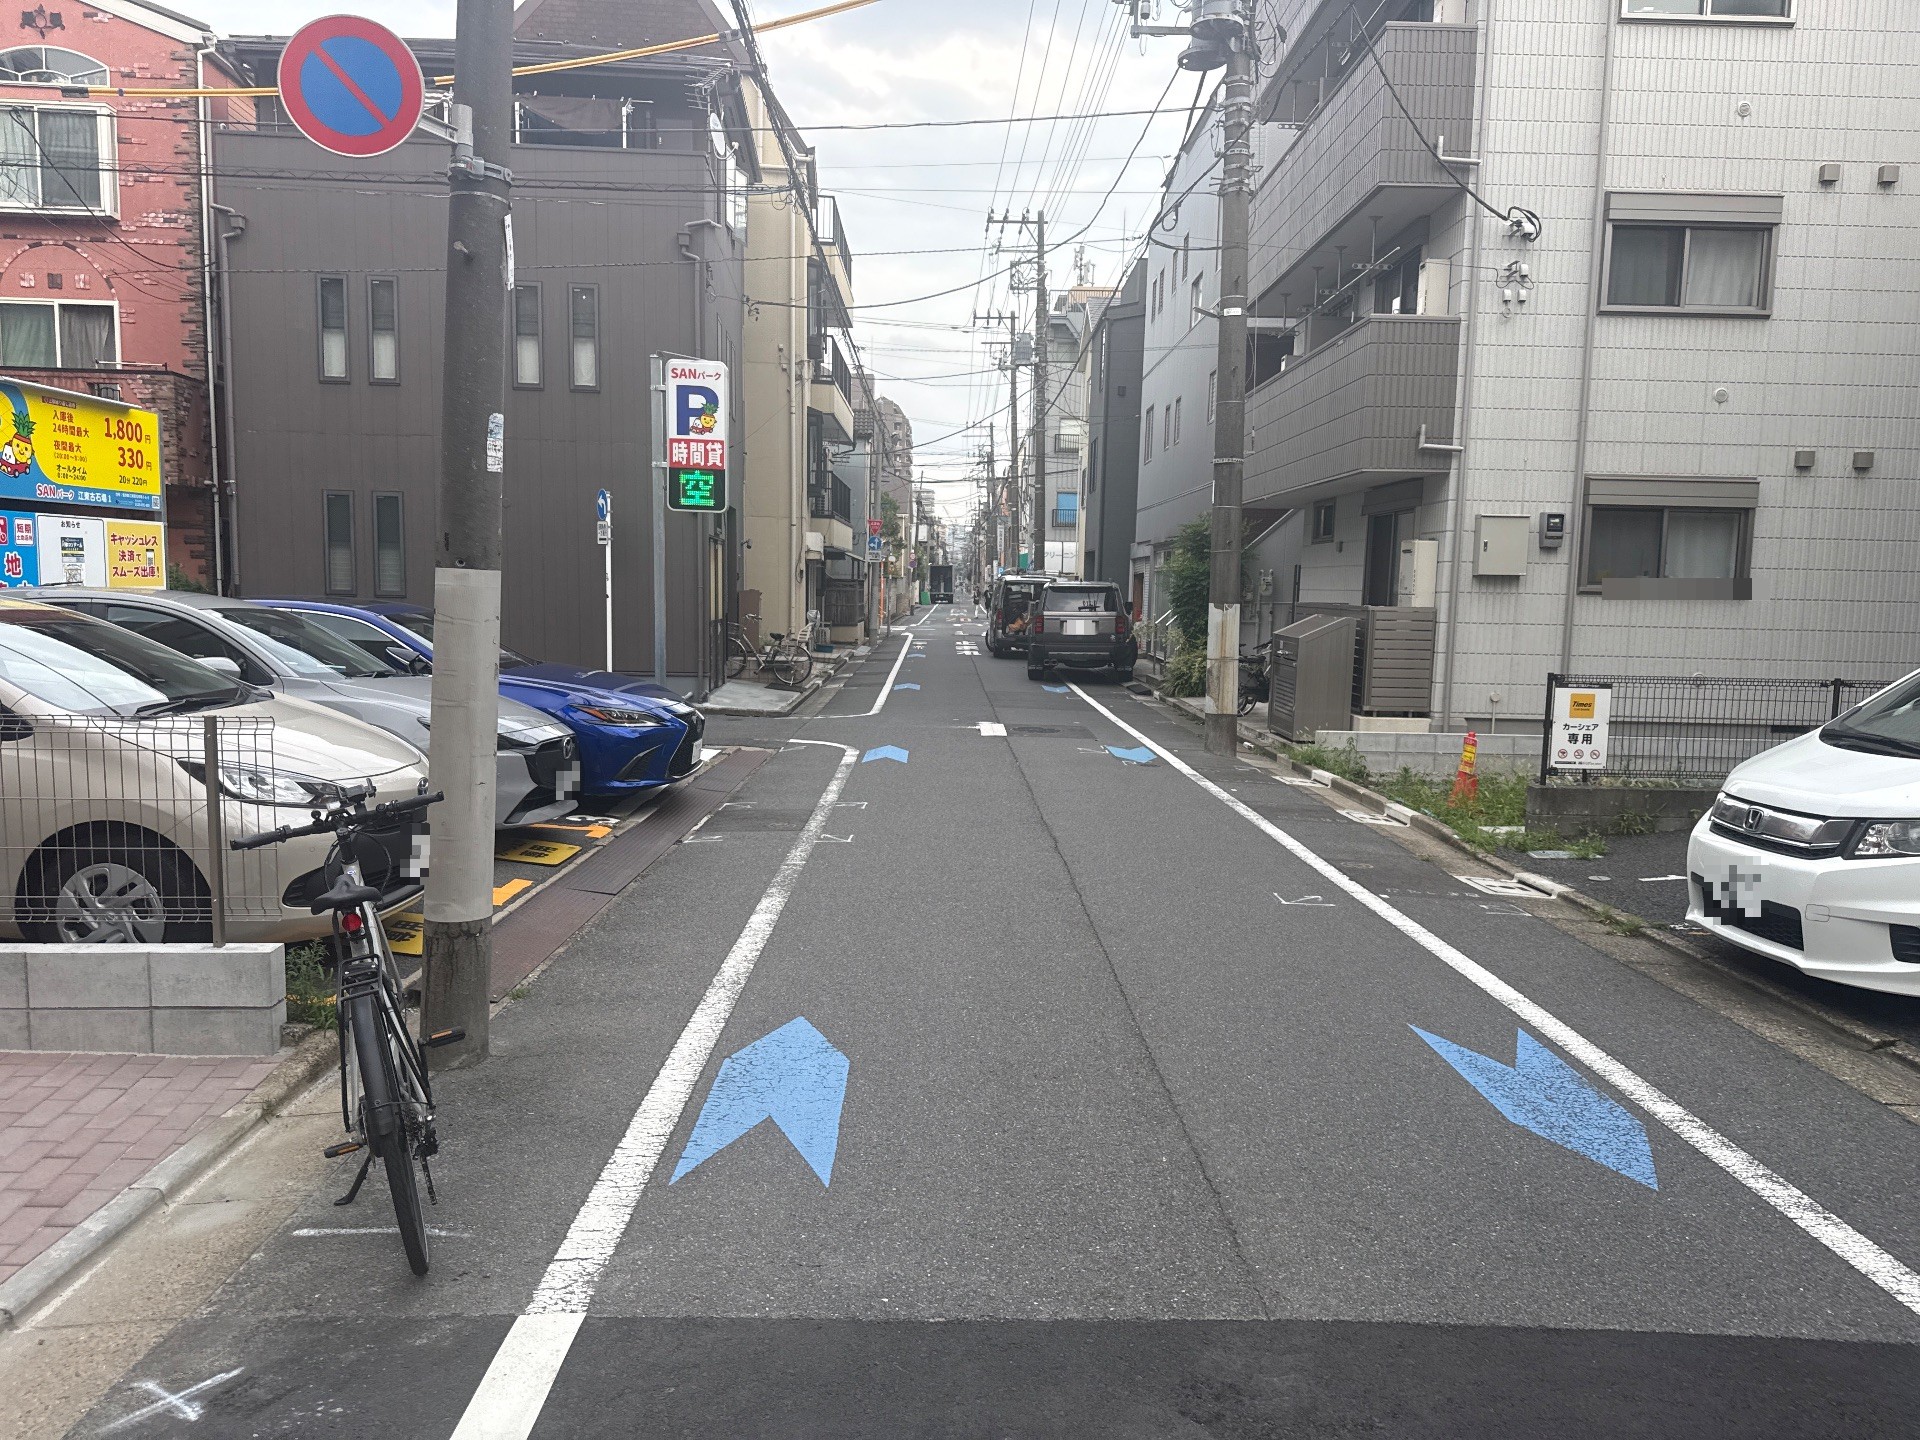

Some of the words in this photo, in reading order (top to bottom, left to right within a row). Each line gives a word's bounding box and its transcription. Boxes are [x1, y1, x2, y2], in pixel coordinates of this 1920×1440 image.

[671, 367, 722, 381] SANパーク
[52, 409, 74, 423] 入庫後
[676, 384, 719, 436] P
[52, 423, 90, 438] 24時間最大
[53, 440, 82, 454] 夜間最大
[672, 441, 723, 466] 時間貸
[56, 464, 88, 475] オールタイム
[36, 483, 75, 501] SANパーク
[679, 470, 715, 507] 空
[16, 523, 32, 534] 短期
[60, 520, 81, 529] お知らせ
[110, 533, 158, 547] キャッシュレス
[1045, 551, 1079, 560] クリーニン
[5, 553, 22, 576] 地
[1562, 723, 1599, 731] カーシェア
[1567, 733, 1593, 745] 専用
